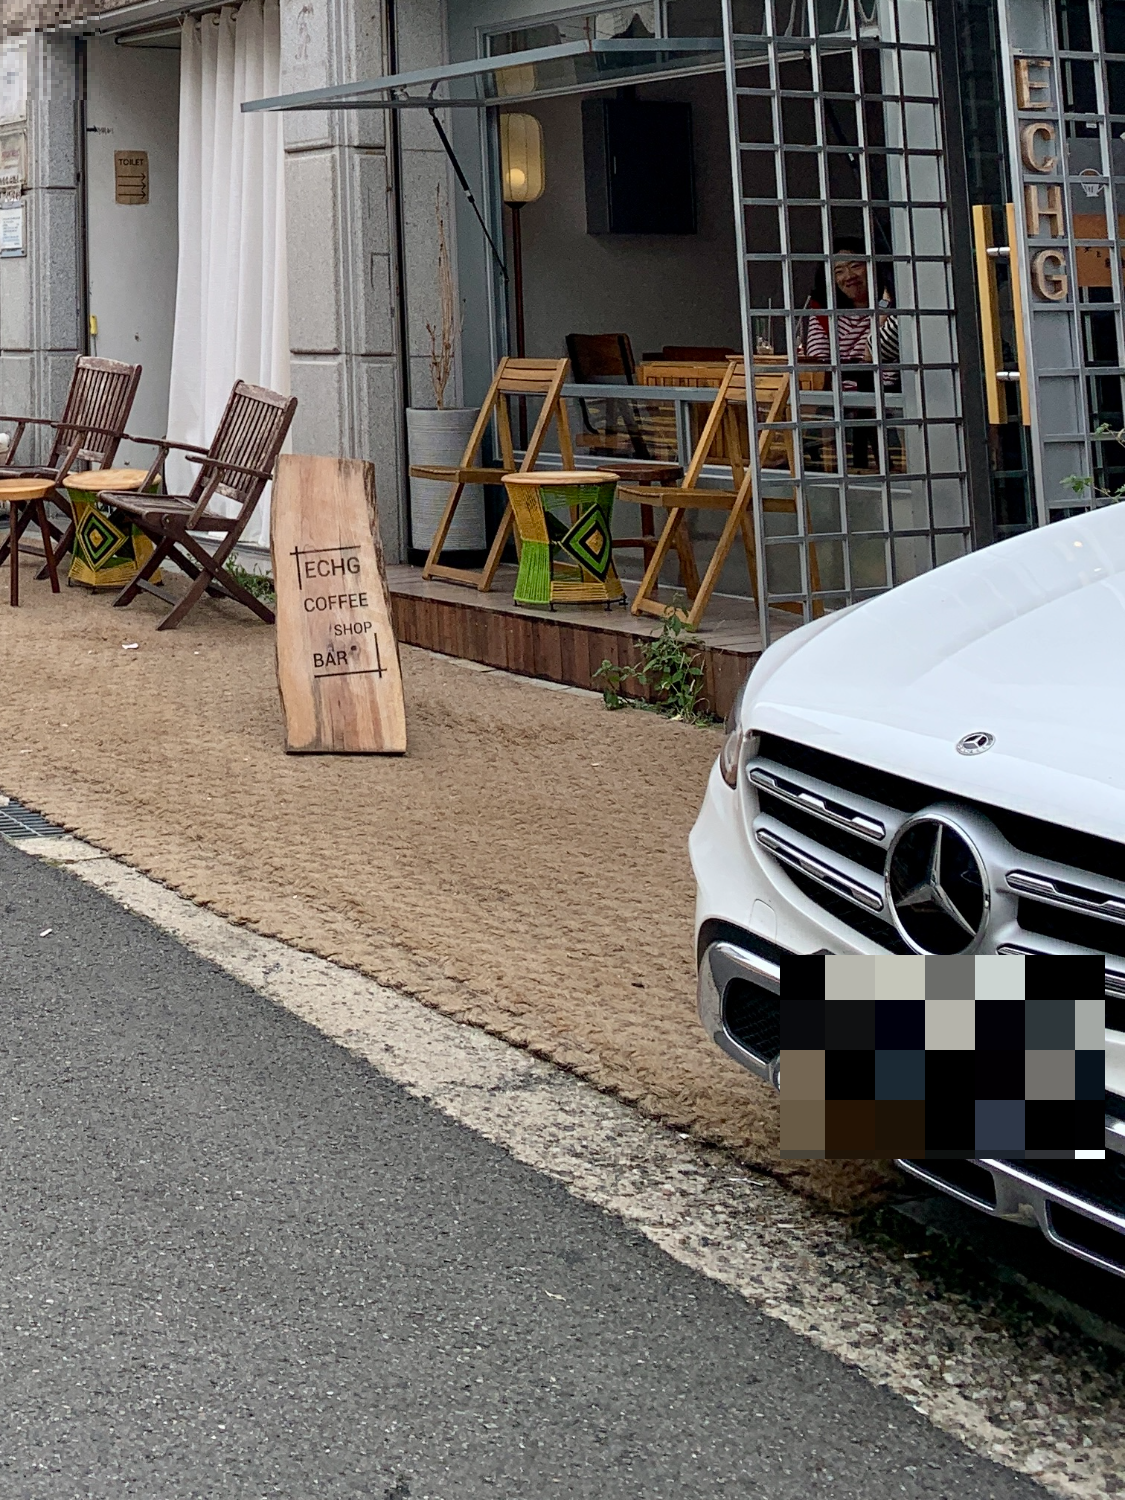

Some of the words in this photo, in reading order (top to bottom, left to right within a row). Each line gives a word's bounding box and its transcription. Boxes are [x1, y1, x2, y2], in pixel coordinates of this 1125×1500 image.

[118, 158, 144, 166] TOILET
[304, 557, 361, 579] ECHG
[304, 592, 369, 613] COFFEE
[334, 621, 373, 636] SHOP
[313, 651, 349, 668] BAR
